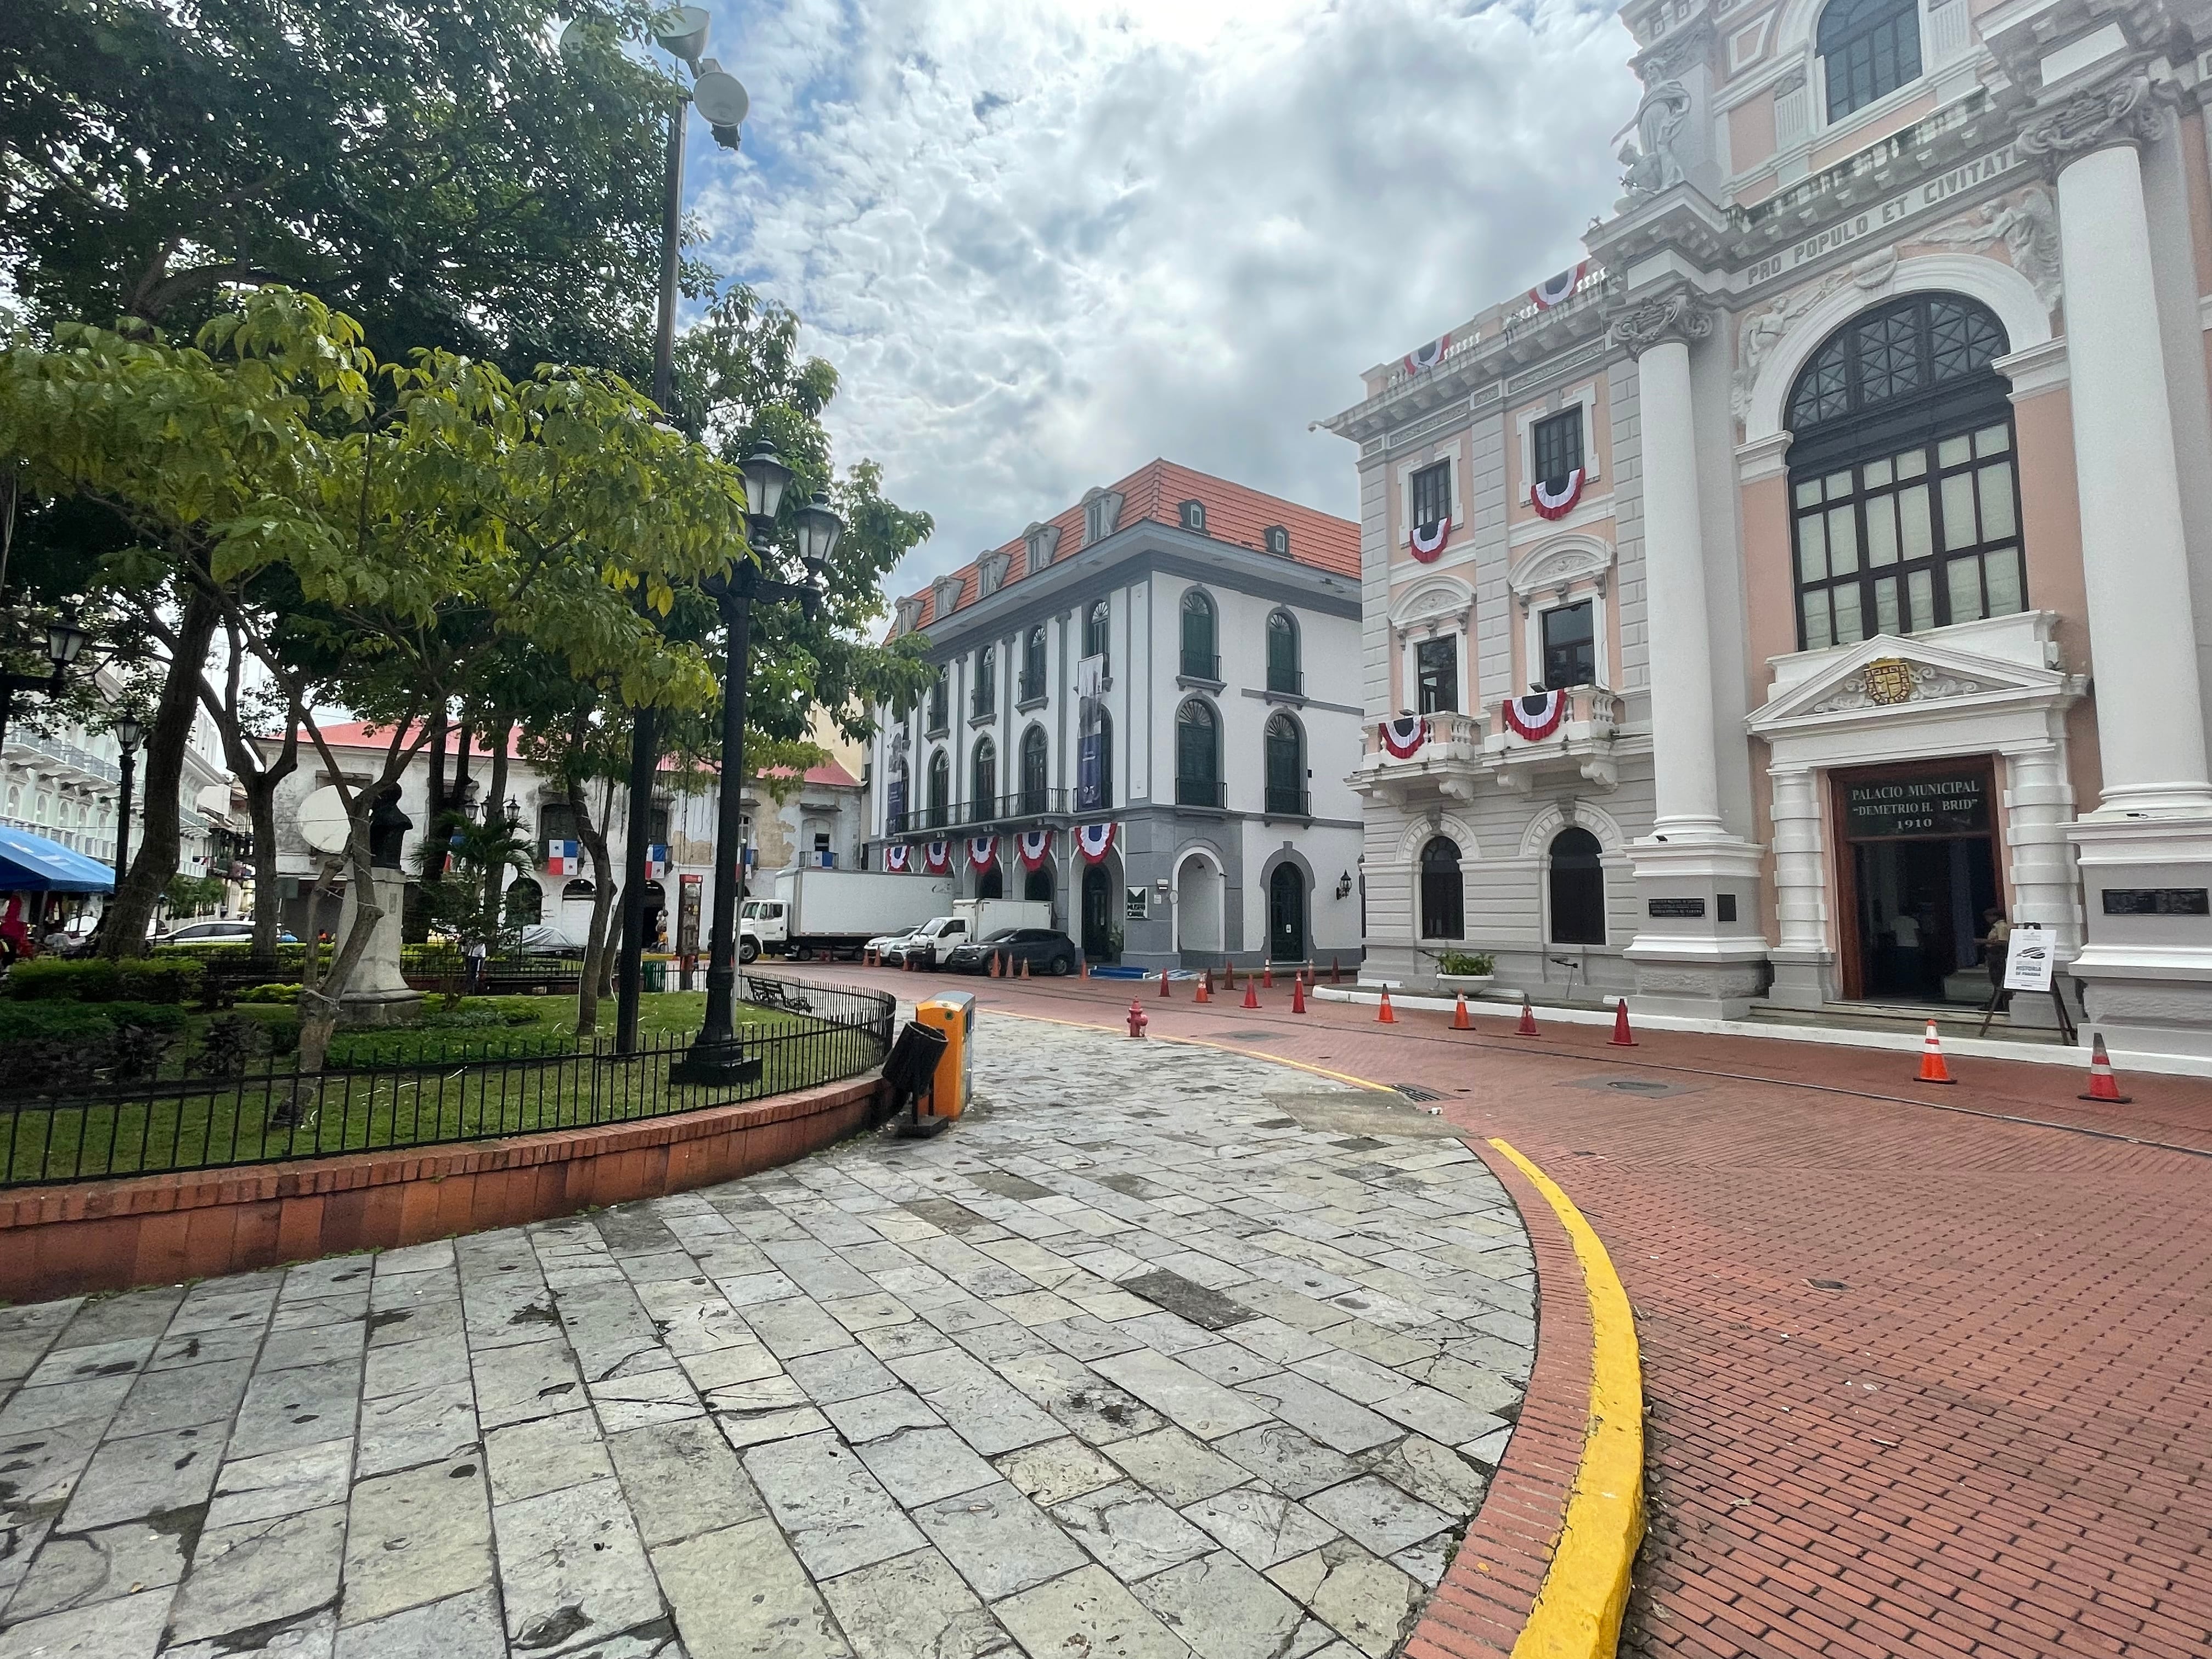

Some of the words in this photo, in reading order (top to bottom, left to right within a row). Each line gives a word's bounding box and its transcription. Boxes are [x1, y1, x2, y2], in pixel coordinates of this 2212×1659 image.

[1748, 256, 1781, 284] PRO
[1794, 216, 1868, 264] POPULO
[1882, 195, 1908, 223] ET
[1852, 787, 1903, 800] PALACIO
[1907, 780, 1979, 797] MUNICIPAL
[1922, 803, 1933, 812] H.
[1942, 798, 1978, 811] BRID"
[1898, 818, 1932, 831] 1910
